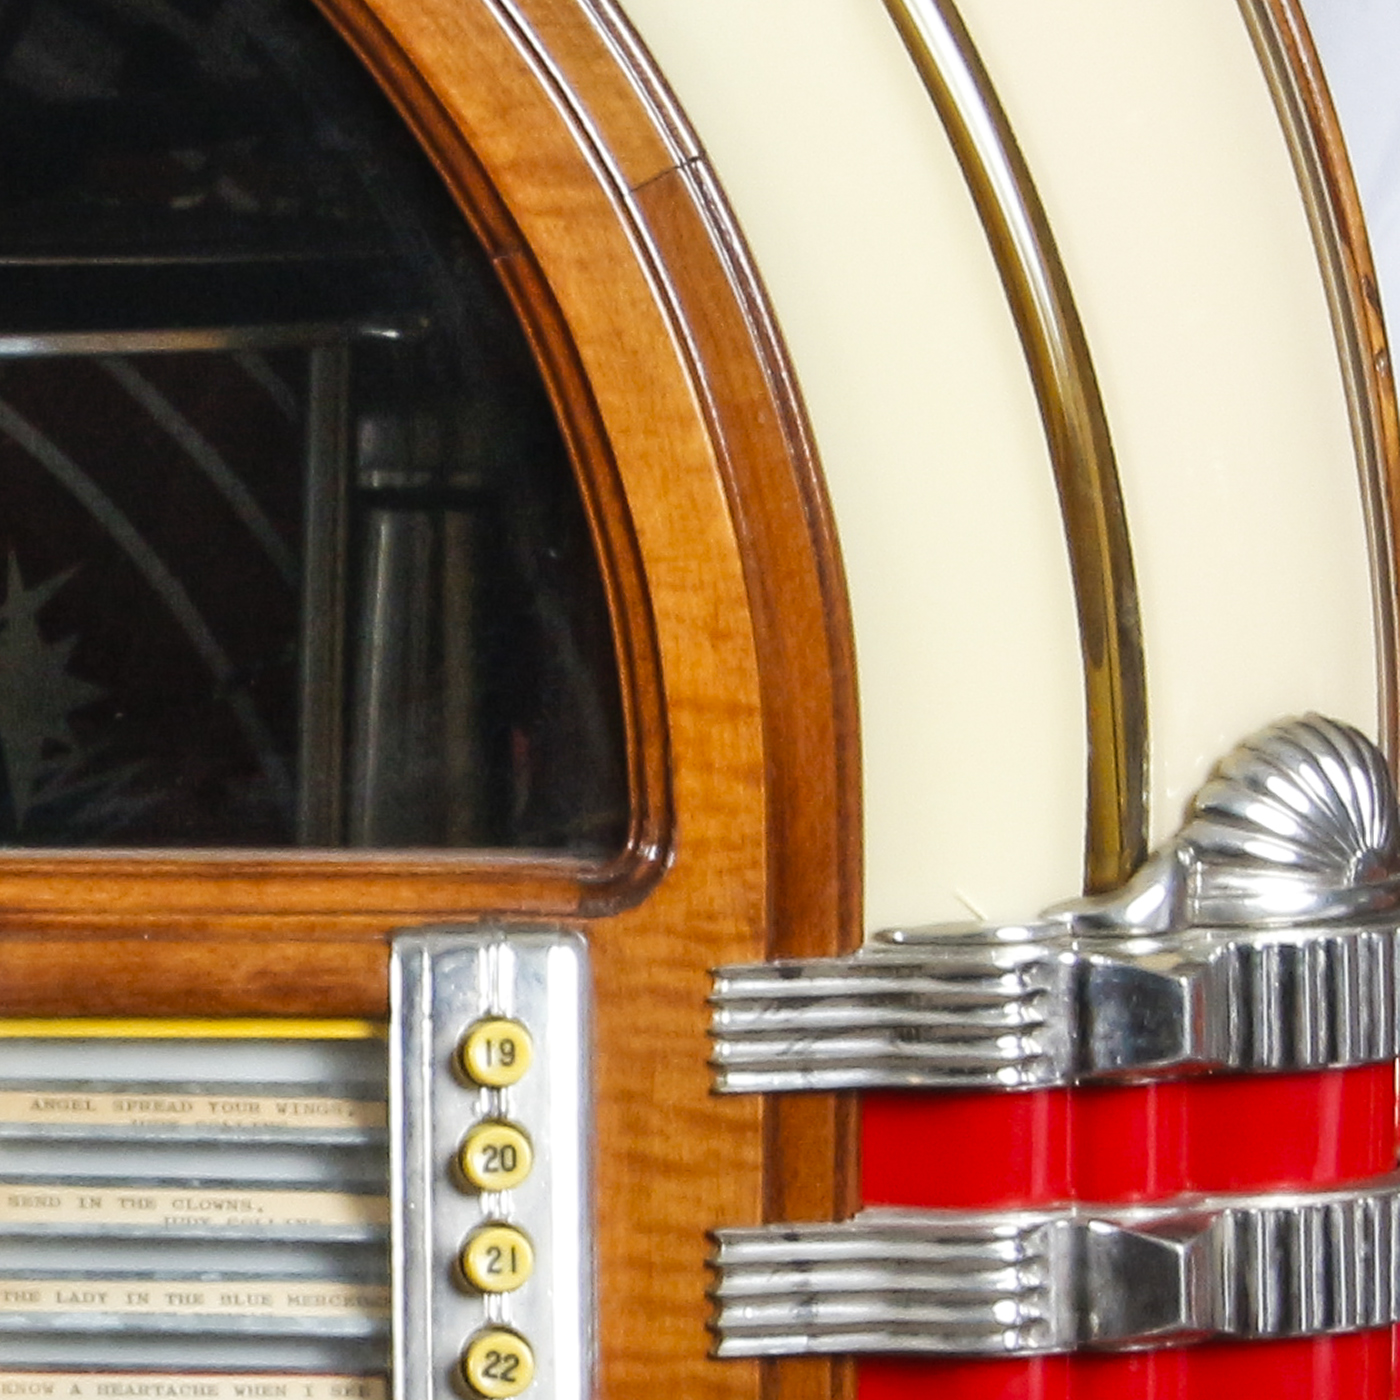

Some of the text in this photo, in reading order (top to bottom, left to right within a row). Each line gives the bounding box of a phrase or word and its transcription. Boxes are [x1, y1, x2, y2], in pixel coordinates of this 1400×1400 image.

[485, 1038, 515, 1067] 19
[30, 1099, 96, 1111] ANGEL
[112, 1100, 194, 1113] SPREAD
[207, 1101, 261, 1114] YOUR
[482, 1144, 516, 1173] 20
[7, 1195, 61, 1208] SEND
[78, 1197, 102, 1209] IN
[118, 1197, 157, 1209] THE
[485, 1245, 517, 1275] 21
[2, 1290, 41, 1303] THE
[55, 1291, 108, 1304] LADY
[126, 1292, 150, 1304] IN
[165, 1292, 204, 1305] THE
[220, 1293, 273, 1306] BLUE
[483, 1351, 518, 1383] 22
[1, 1383, 371, 1398] KNOW A HEARTACHE WHEN I SEE
